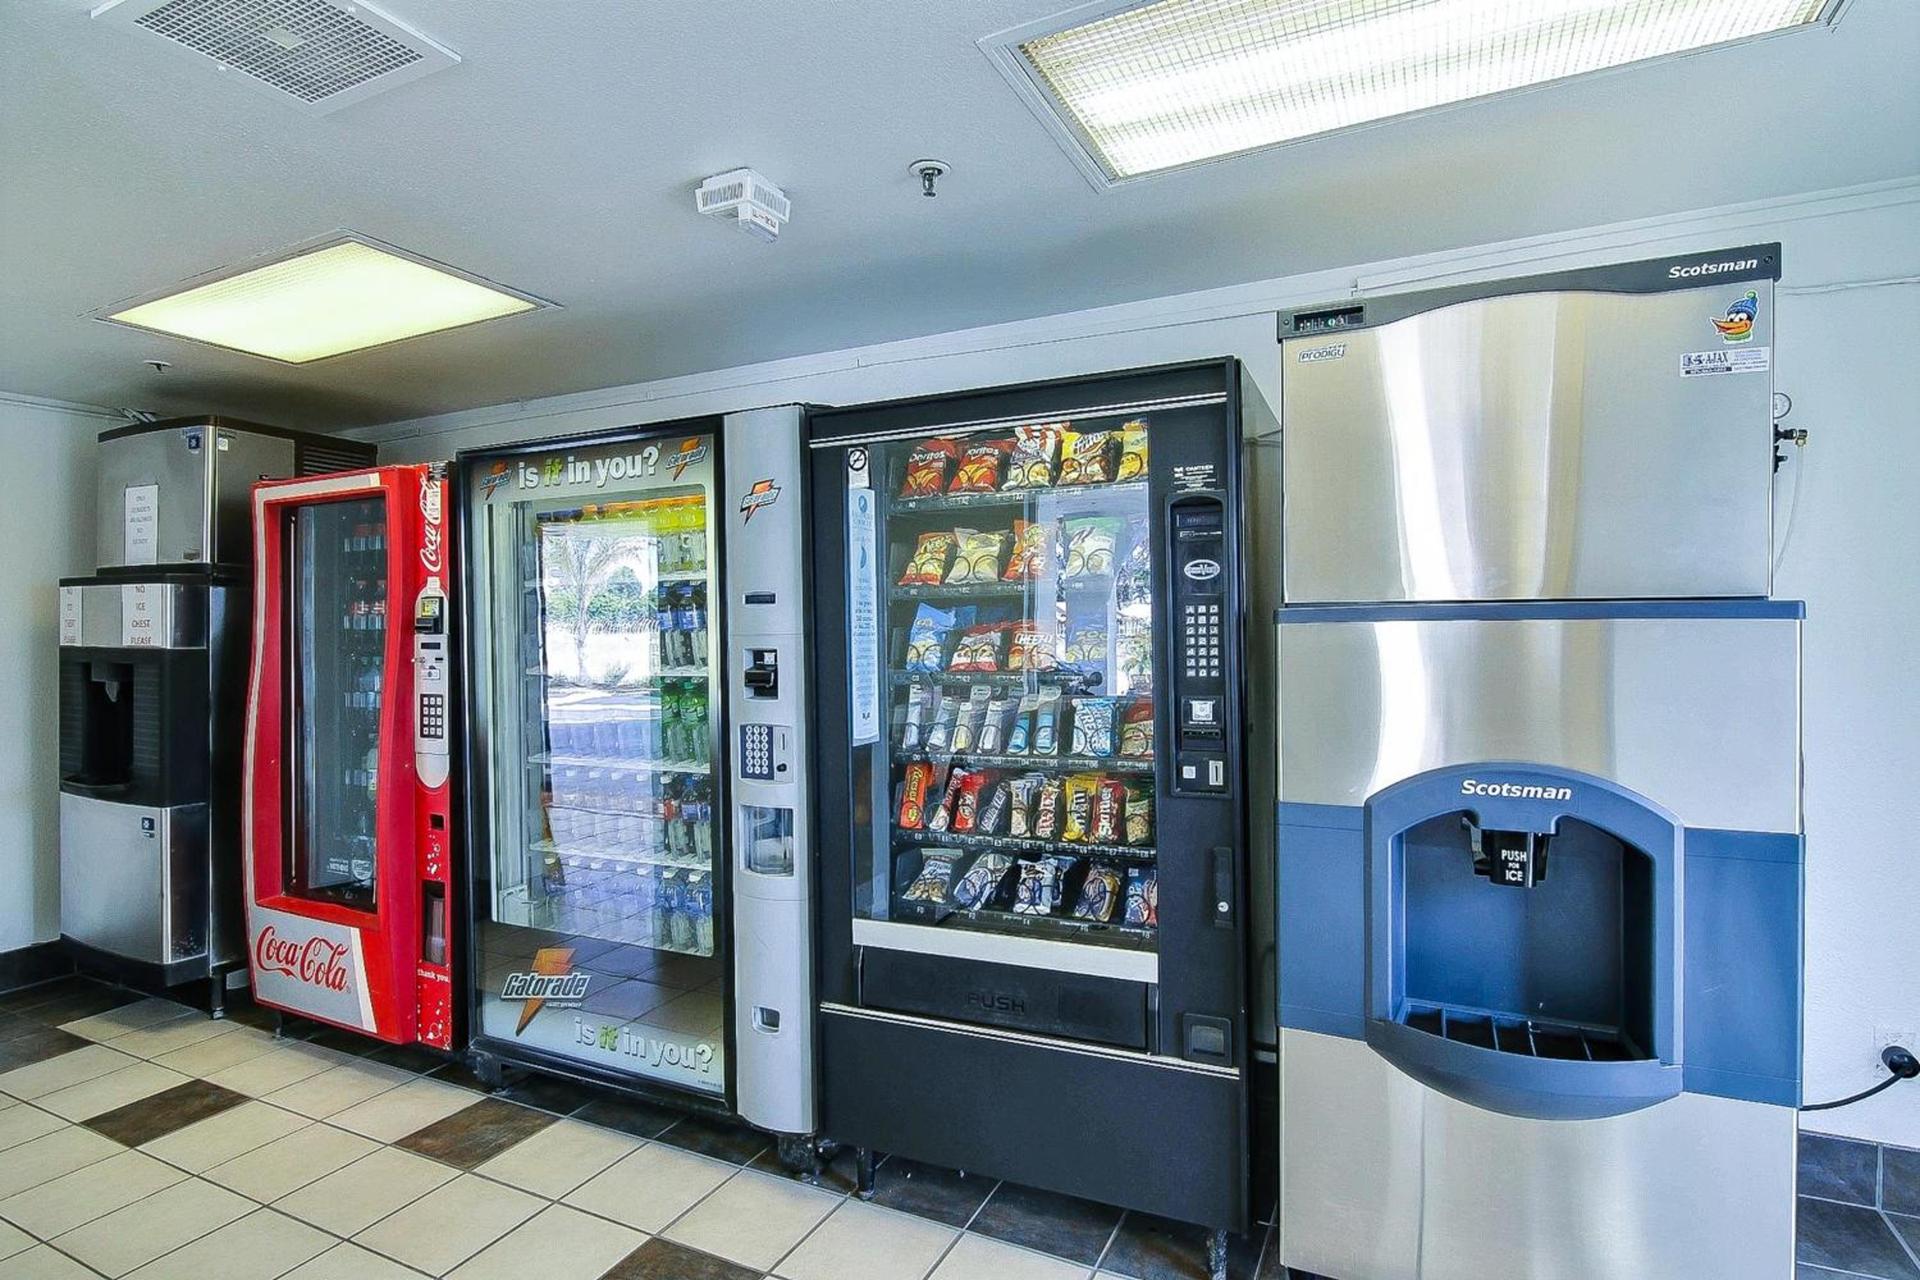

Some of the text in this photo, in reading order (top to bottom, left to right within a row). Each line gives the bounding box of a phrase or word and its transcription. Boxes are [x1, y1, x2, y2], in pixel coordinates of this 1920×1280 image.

[1668, 259, 1758, 279] Scotsman
[909, 450, 946, 462] Doritos
[519, 446, 659, 489] is it in you?
[135, 585, 146, 593] NO
[136, 602, 146, 611] ICE
[131, 619, 151, 628] CHEST
[1461, 779, 1572, 800] Scotsman
[1501, 850, 1527, 862] PUSH
[1505, 870, 1523, 881] ICE
[256, 926, 349, 992] Coca-Cola
[503, 973, 587, 997] Gatorade
[967, 993, 1025, 1013] PUSH
[575, 1016, 714, 1073] is it in you?
